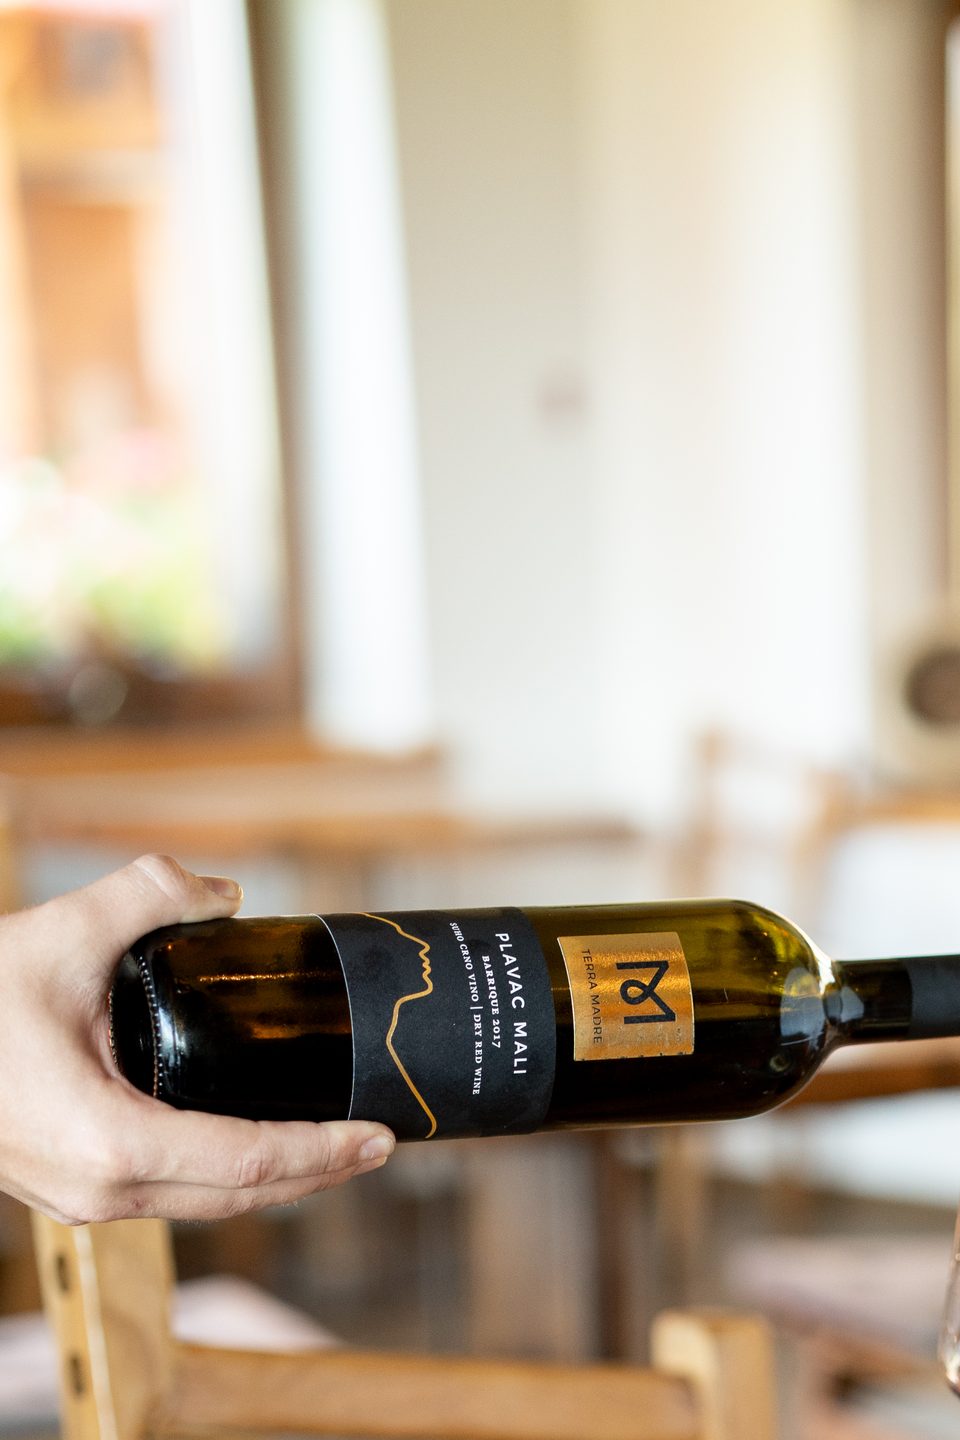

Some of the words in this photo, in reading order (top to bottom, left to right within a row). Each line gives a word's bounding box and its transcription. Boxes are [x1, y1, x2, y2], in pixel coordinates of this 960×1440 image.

[450, 922, 465, 942] SUHO
[460, 943, 474, 970] CRNO
[468, 973, 480, 1002] VINO
[482, 955, 500, 1015] BARRIQUE
[491, 1019, 501, 1048] 2017
[581, 949, 597, 990] TERRA
[591, 995, 603, 1044] MADRE
[495, 933, 525, 1009] PLAVAC
[513, 1021, 528, 1074] MALI
[473, 1014, 482, 1037] DRY
[475, 1041, 483, 1064] RED
[472, 1067, 482, 1095] WINE
